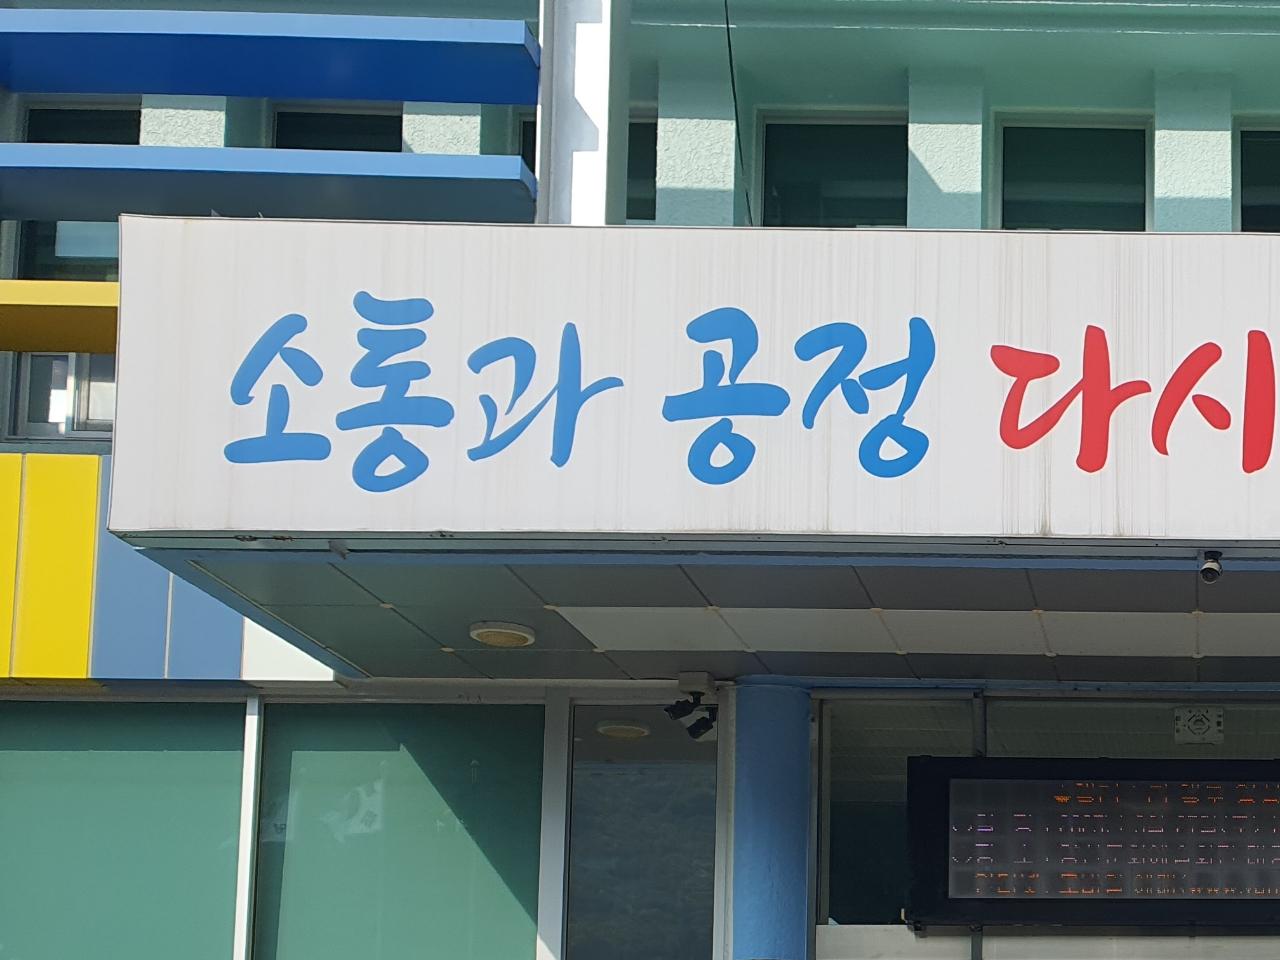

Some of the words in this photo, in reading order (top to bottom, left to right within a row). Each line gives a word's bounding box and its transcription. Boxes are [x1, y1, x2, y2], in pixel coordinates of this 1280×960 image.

[224, 291, 624, 493] 소통과
[662, 306, 936, 486] 공정
[990, 324, 1276, 475] 다시
